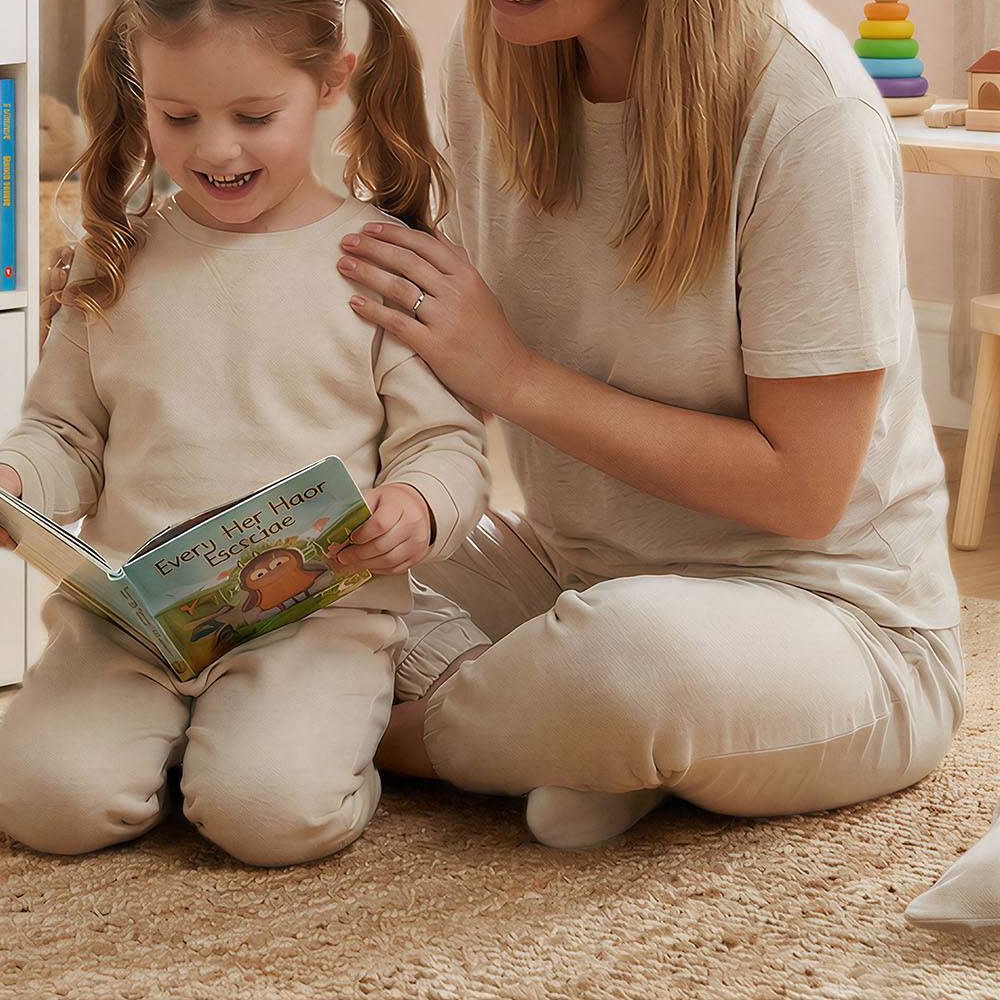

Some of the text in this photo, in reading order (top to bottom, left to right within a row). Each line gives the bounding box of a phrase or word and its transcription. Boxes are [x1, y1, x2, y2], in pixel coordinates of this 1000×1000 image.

[154, 481, 327, 577] Every Her Haor
